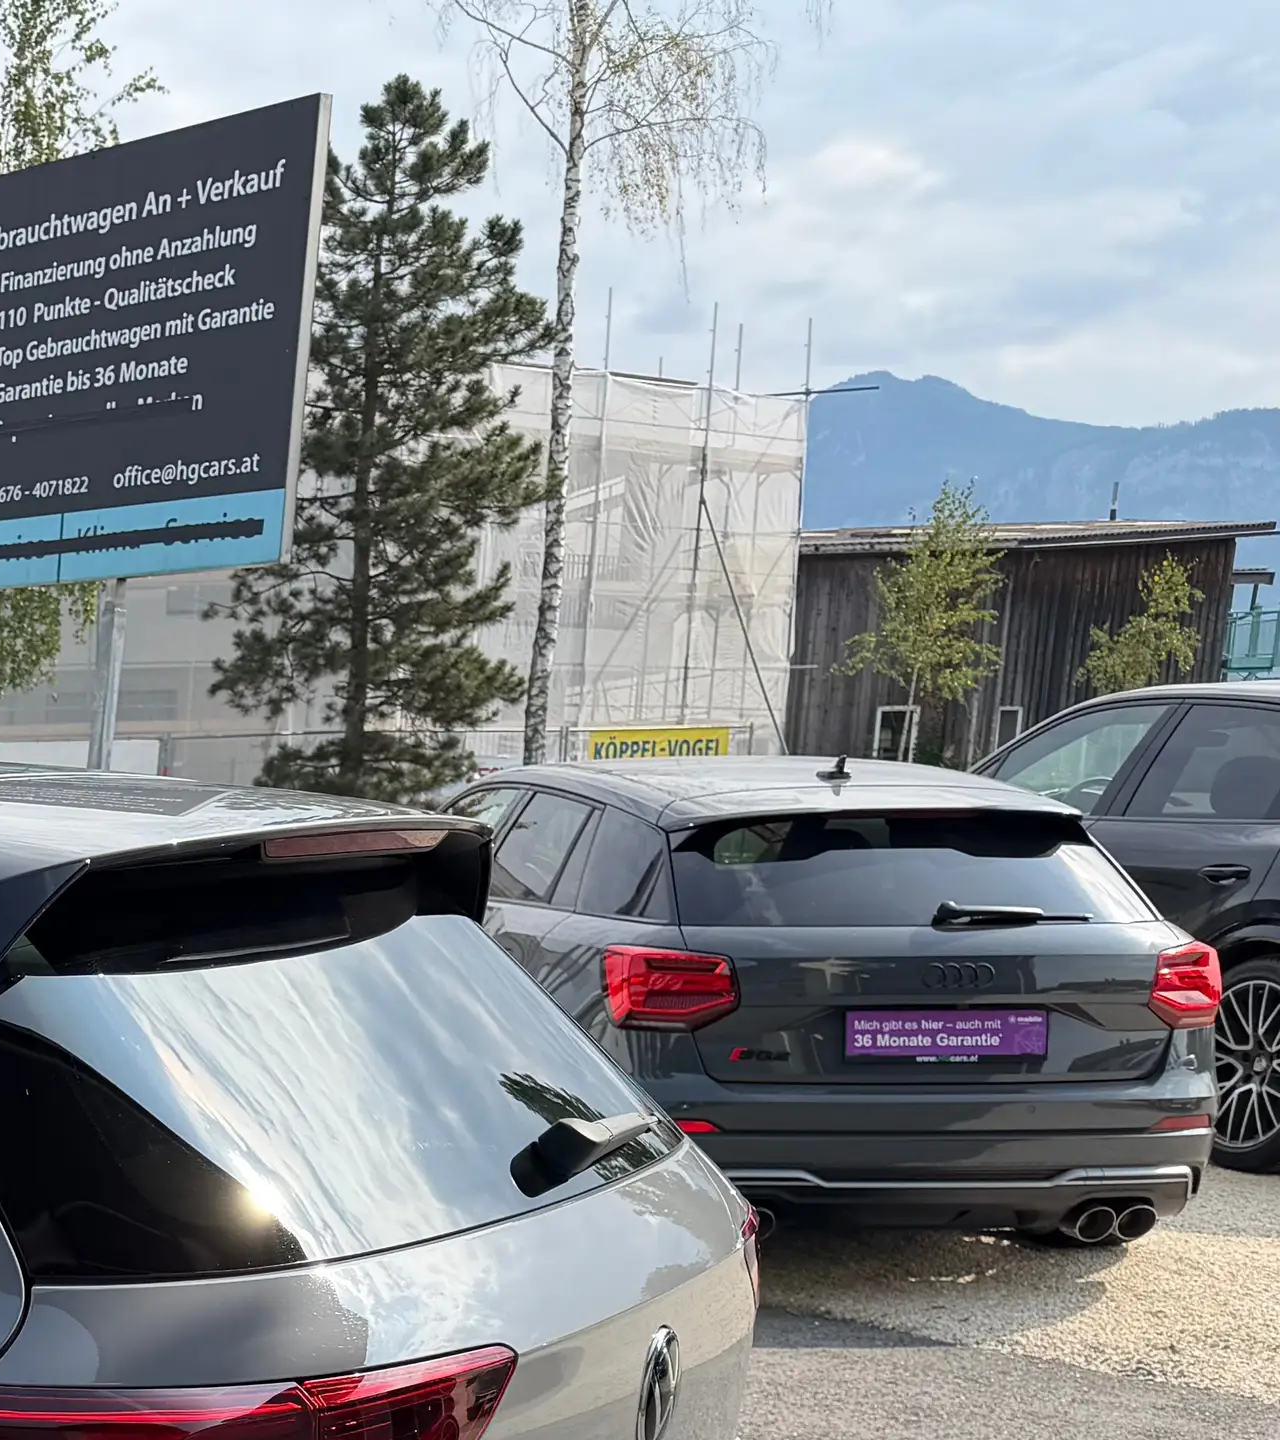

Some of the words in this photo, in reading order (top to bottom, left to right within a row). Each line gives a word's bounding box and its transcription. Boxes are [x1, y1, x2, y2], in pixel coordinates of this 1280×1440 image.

[142, 190, 172, 218] An
[177, 188, 192, 209] +
[196, 158, 286, 205] Verkauf
[0, 254, 106, 292] Finanzierung
[109, 245, 154, 270] ohne
[157, 223, 257, 260] Anzahlung
[33, 296, 91, 324] Punkte
[104, 263, 236, 311] Qualitätscheck
[26, 322, 162, 361] Gebrauchtwagen
[164, 312, 195, 337] mit
[197, 298, 276, 332] Garantie
[66, 369, 92, 393] bis
[93, 365, 116, 388] 36
[118, 356, 189, 384] Monate
[32, 476, 89, 497] 4071822
[113, 453, 261, 489] office@hgcars.at
[854, 1020, 880, 1030] Mich
[882, 1020, 903, 1032] gibt
[905, 1022, 918, 1030] es
[921, 1019, 944, 1030] hier
[956, 1020, 982, 1029] auch
[985, 1019, 1001, 1029] mit
[854, 1034, 872, 1047] 36
[877, 1034, 932, 1047] Monate
